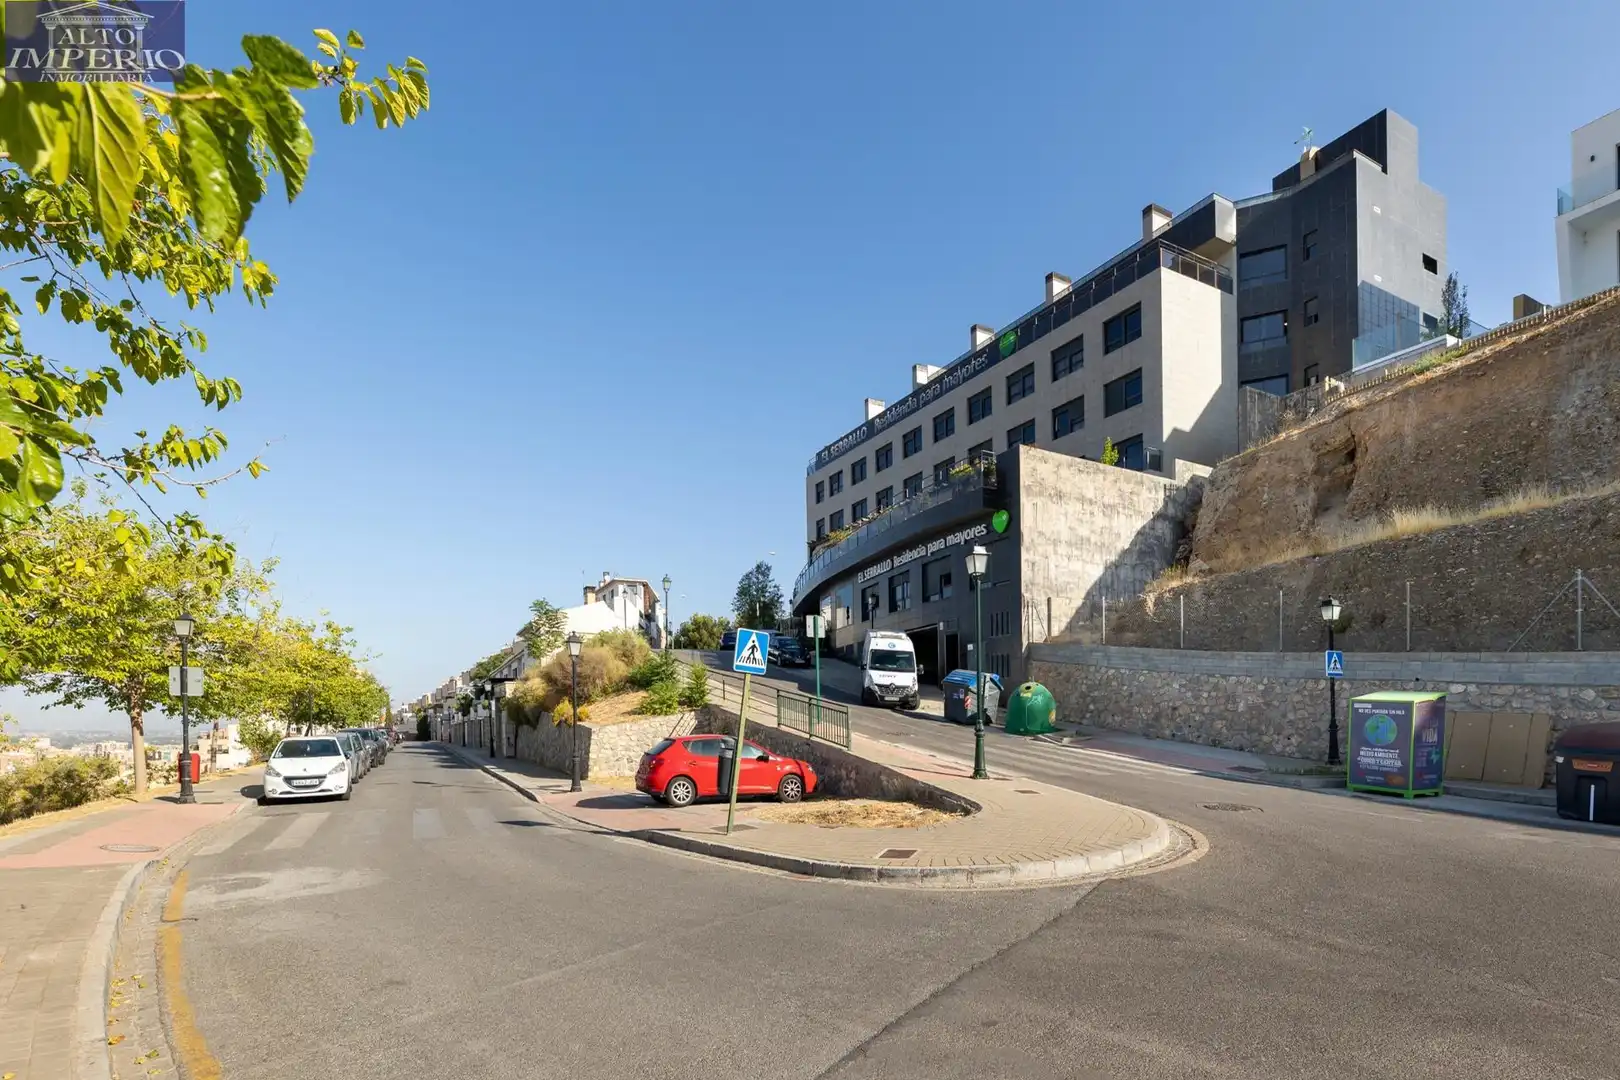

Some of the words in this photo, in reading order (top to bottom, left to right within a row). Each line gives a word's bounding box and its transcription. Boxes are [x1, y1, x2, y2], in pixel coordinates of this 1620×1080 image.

[830, 426, 868, 458] SERRALLO
[874, 397, 918, 434] Residencia
[919, 383, 941, 409] para
[942, 351, 989, 392] mayores
[864, 559, 892, 580] SERRALLO
[893, 544, 927, 567] Residencia
[927, 538, 945, 557] para
[946, 523, 987, 545] mayores
